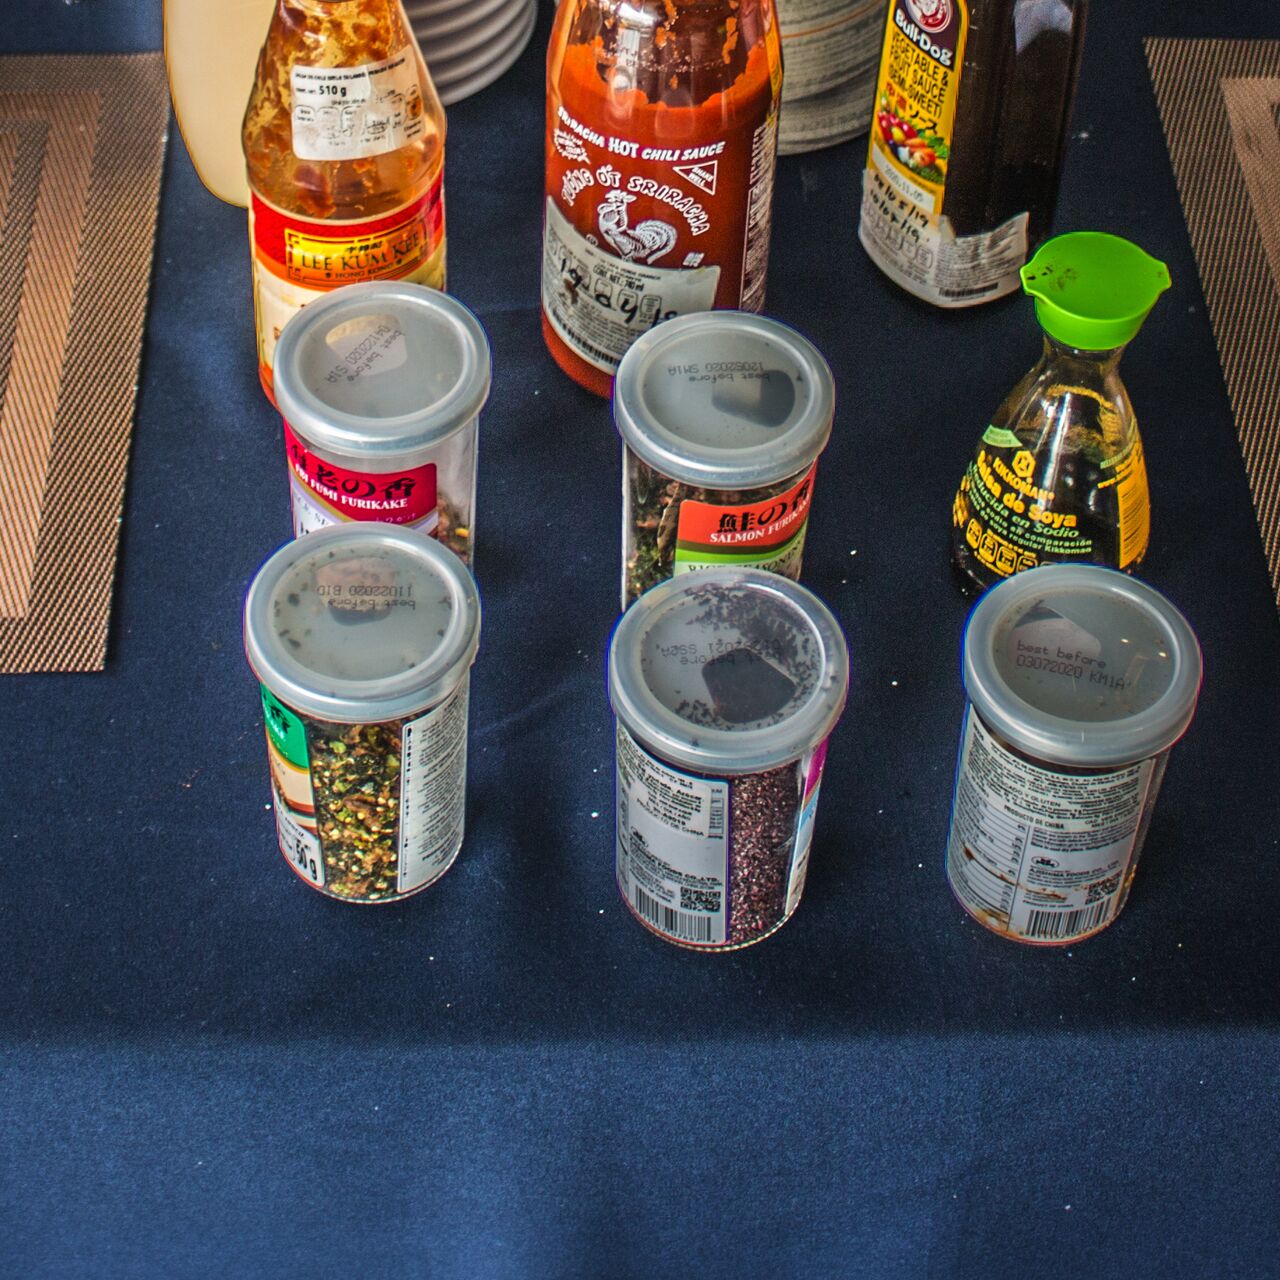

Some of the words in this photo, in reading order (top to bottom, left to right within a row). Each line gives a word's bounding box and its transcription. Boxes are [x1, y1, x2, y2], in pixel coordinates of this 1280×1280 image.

[895, 8, 952, 66] Bull-Dog
[892, 28, 940, 81] VEGETABLE
[941, 71, 949, 87] &
[319, 85, 338, 95] 510
[340, 86, 347, 97] g
[912, 68, 946, 105] SAUCE
[608, 136, 639, 158] HOT
[641, 146, 680, 161] CHILI
[681, 141, 726, 161] SAUCE
[687, 173, 708, 188] WELL
[691, 166, 715, 183] SHAKE
[627, 175, 711, 237] SRIRACHA
[302, 254, 333, 271] LEE
[341, 253, 387, 271] KUM
[392, 232, 419, 260] KEE
[380, 329, 406, 348] best
[347, 351, 383, 381] before
[740, 372, 770, 382] best
[688, 373, 735, 384] before
[310, 479, 338, 502] FUMI
[341, 495, 408, 510] FURIKAKE
[1003, 492, 1025, 514] de
[1028, 503, 1077, 529] Soya
[709, 529, 765, 543] SALMON
[989, 519, 1008, 536] soya
[1009, 533, 1042, 550] regular
[1044, 543, 1092, 554] Kikkoman
[1011, 515, 1031, 528] en
[1034, 522, 1080, 538] Sodio
[1024, 532, 1093, 548] comparación
[349, 583, 413, 597] 11022020
[327, 599, 376, 610] before
[384, 599, 416, 611] best
[1017, 639, 1049, 655] best
[1056, 647, 1107, 669] before
[1016, 654, 1083, 680] 03072020
[1044, 820, 1065, 830] CHINA
[309, 857, 318, 882] g
